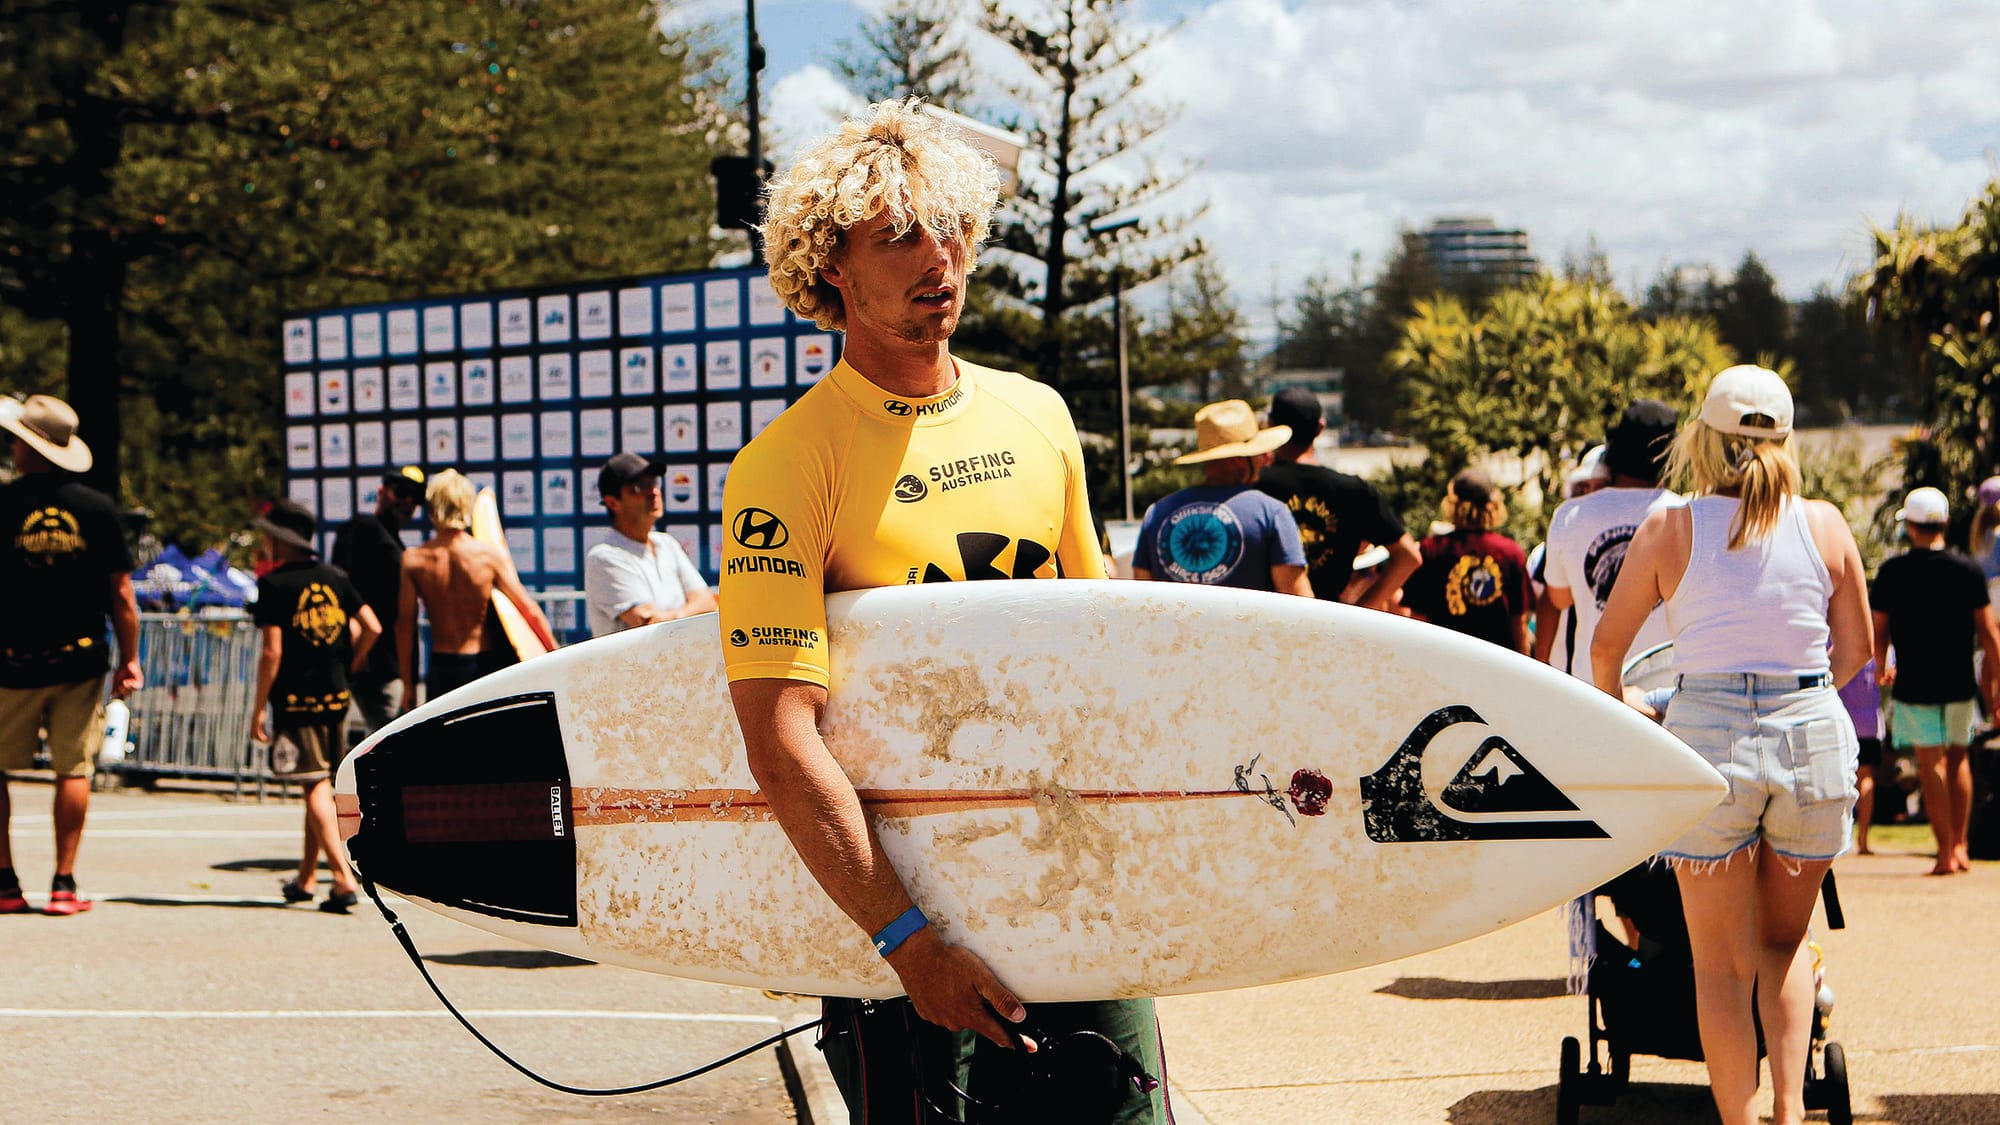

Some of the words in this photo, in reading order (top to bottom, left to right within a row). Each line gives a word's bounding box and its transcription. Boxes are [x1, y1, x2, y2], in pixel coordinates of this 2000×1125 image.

[916, 388, 964, 416] HYUNDAI
[929, 451, 1015, 482] SURFING
[941, 468, 1012, 492] AUSTRALIA
[728, 556, 806, 578] HYUNDAI
[751, 627, 819, 642] SURFING
[759, 638, 815, 649] AUSTRALIA
[552, 788, 562, 834] BALLET
